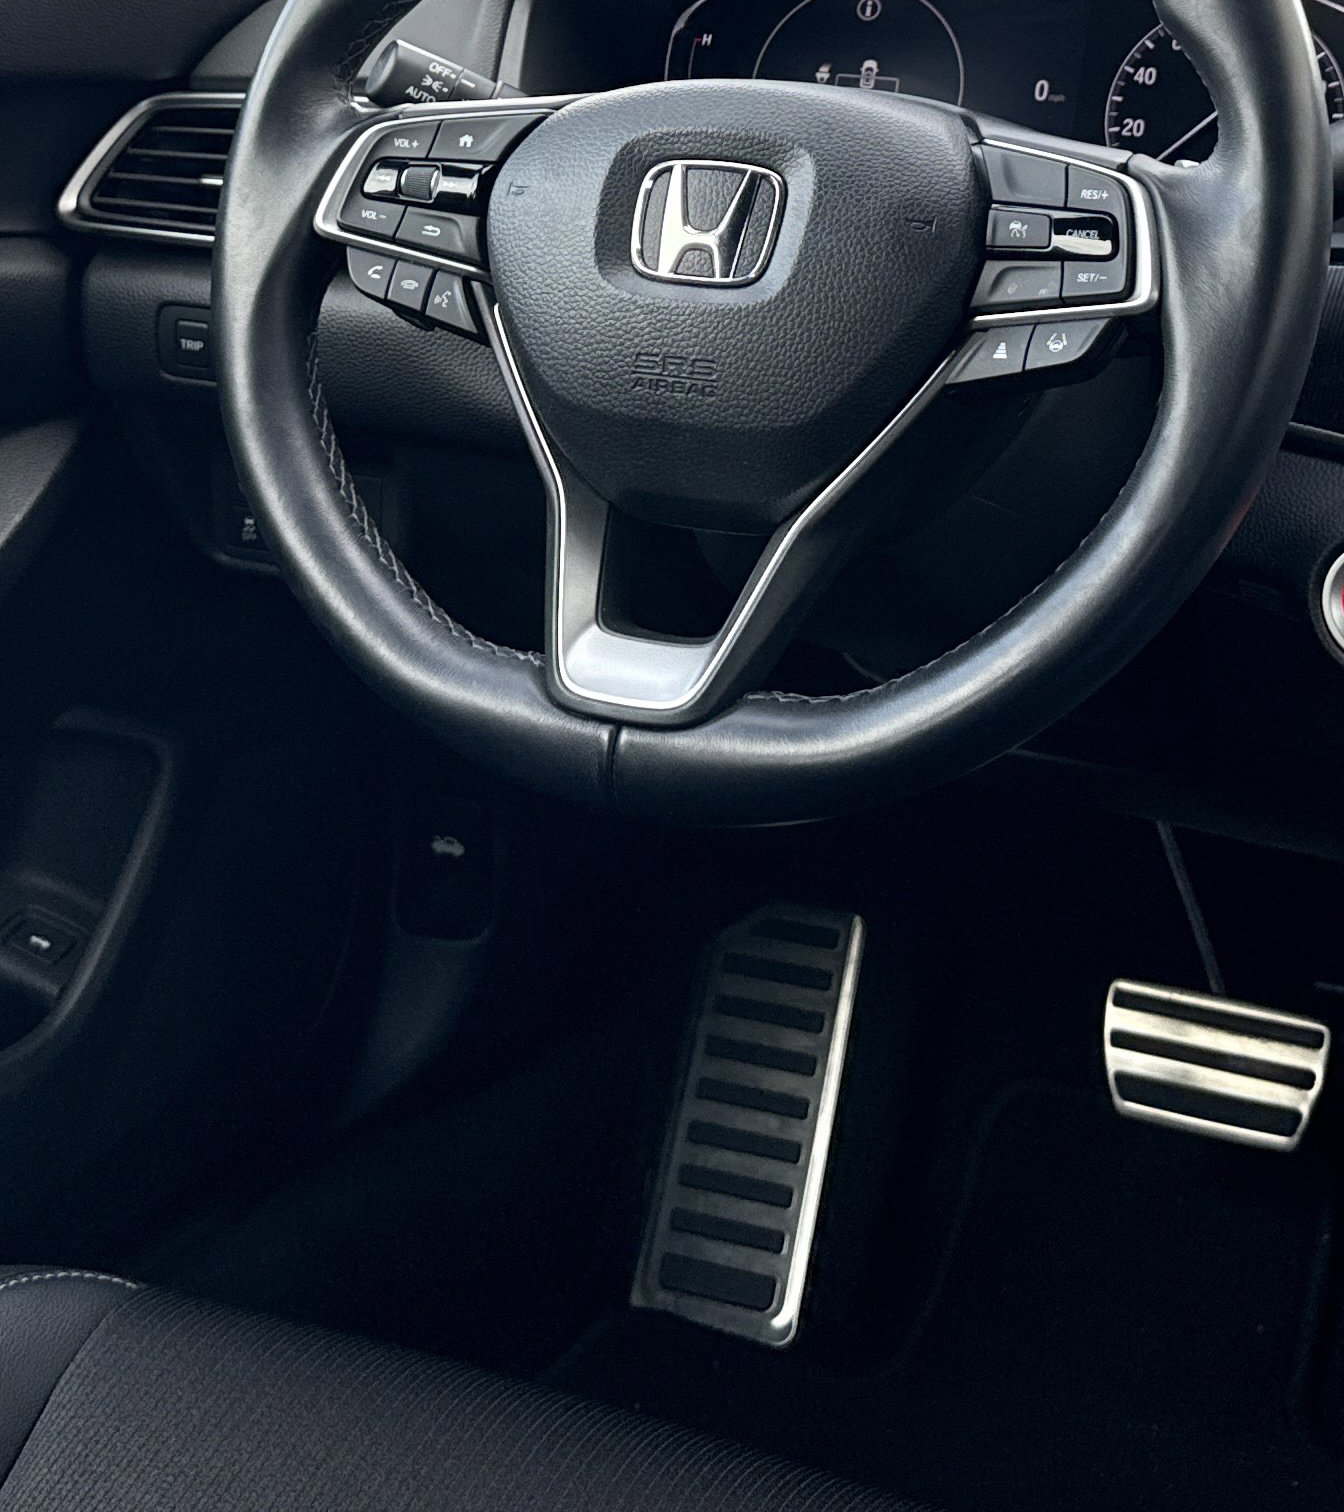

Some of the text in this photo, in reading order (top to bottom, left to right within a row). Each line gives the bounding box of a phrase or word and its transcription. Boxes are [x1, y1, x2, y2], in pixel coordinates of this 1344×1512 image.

[428, 62, 452, 78] OFF
[1133, 66, 1157, 86] 40
[404, 86, 437, 103] AUTO
[1034, 79, 1049, 102] 0
[1121, 117, 1145, 138] 20
[1065, 228, 1101, 240] CANCEL
[179, 338, 205, 352] TRIP
[635, 352, 717, 376] SRS
[631, 376, 718, 398] AIRBAG
